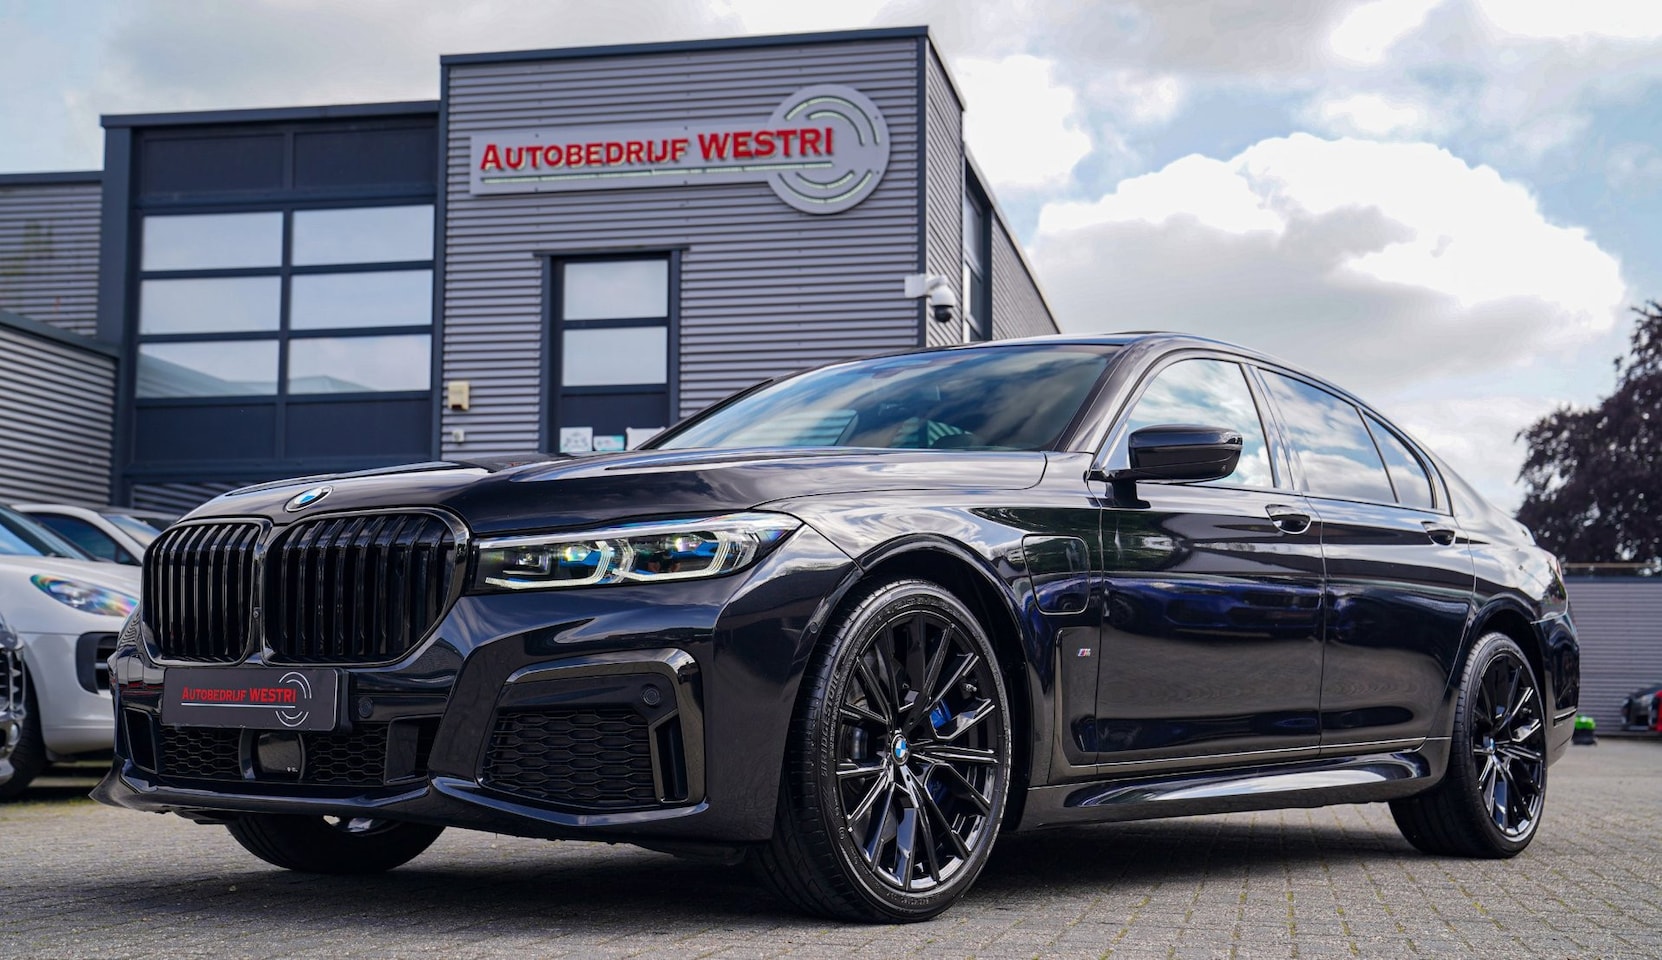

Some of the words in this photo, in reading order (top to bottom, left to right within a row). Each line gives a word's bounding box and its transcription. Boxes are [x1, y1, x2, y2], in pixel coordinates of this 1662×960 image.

[480, 138, 689, 170] AUTOBEDRIJF
[698, 127, 833, 160] WESTRI
[181, 687, 246, 702] AUTOBEDRIJF
[249, 687, 297, 703] WESTRI
